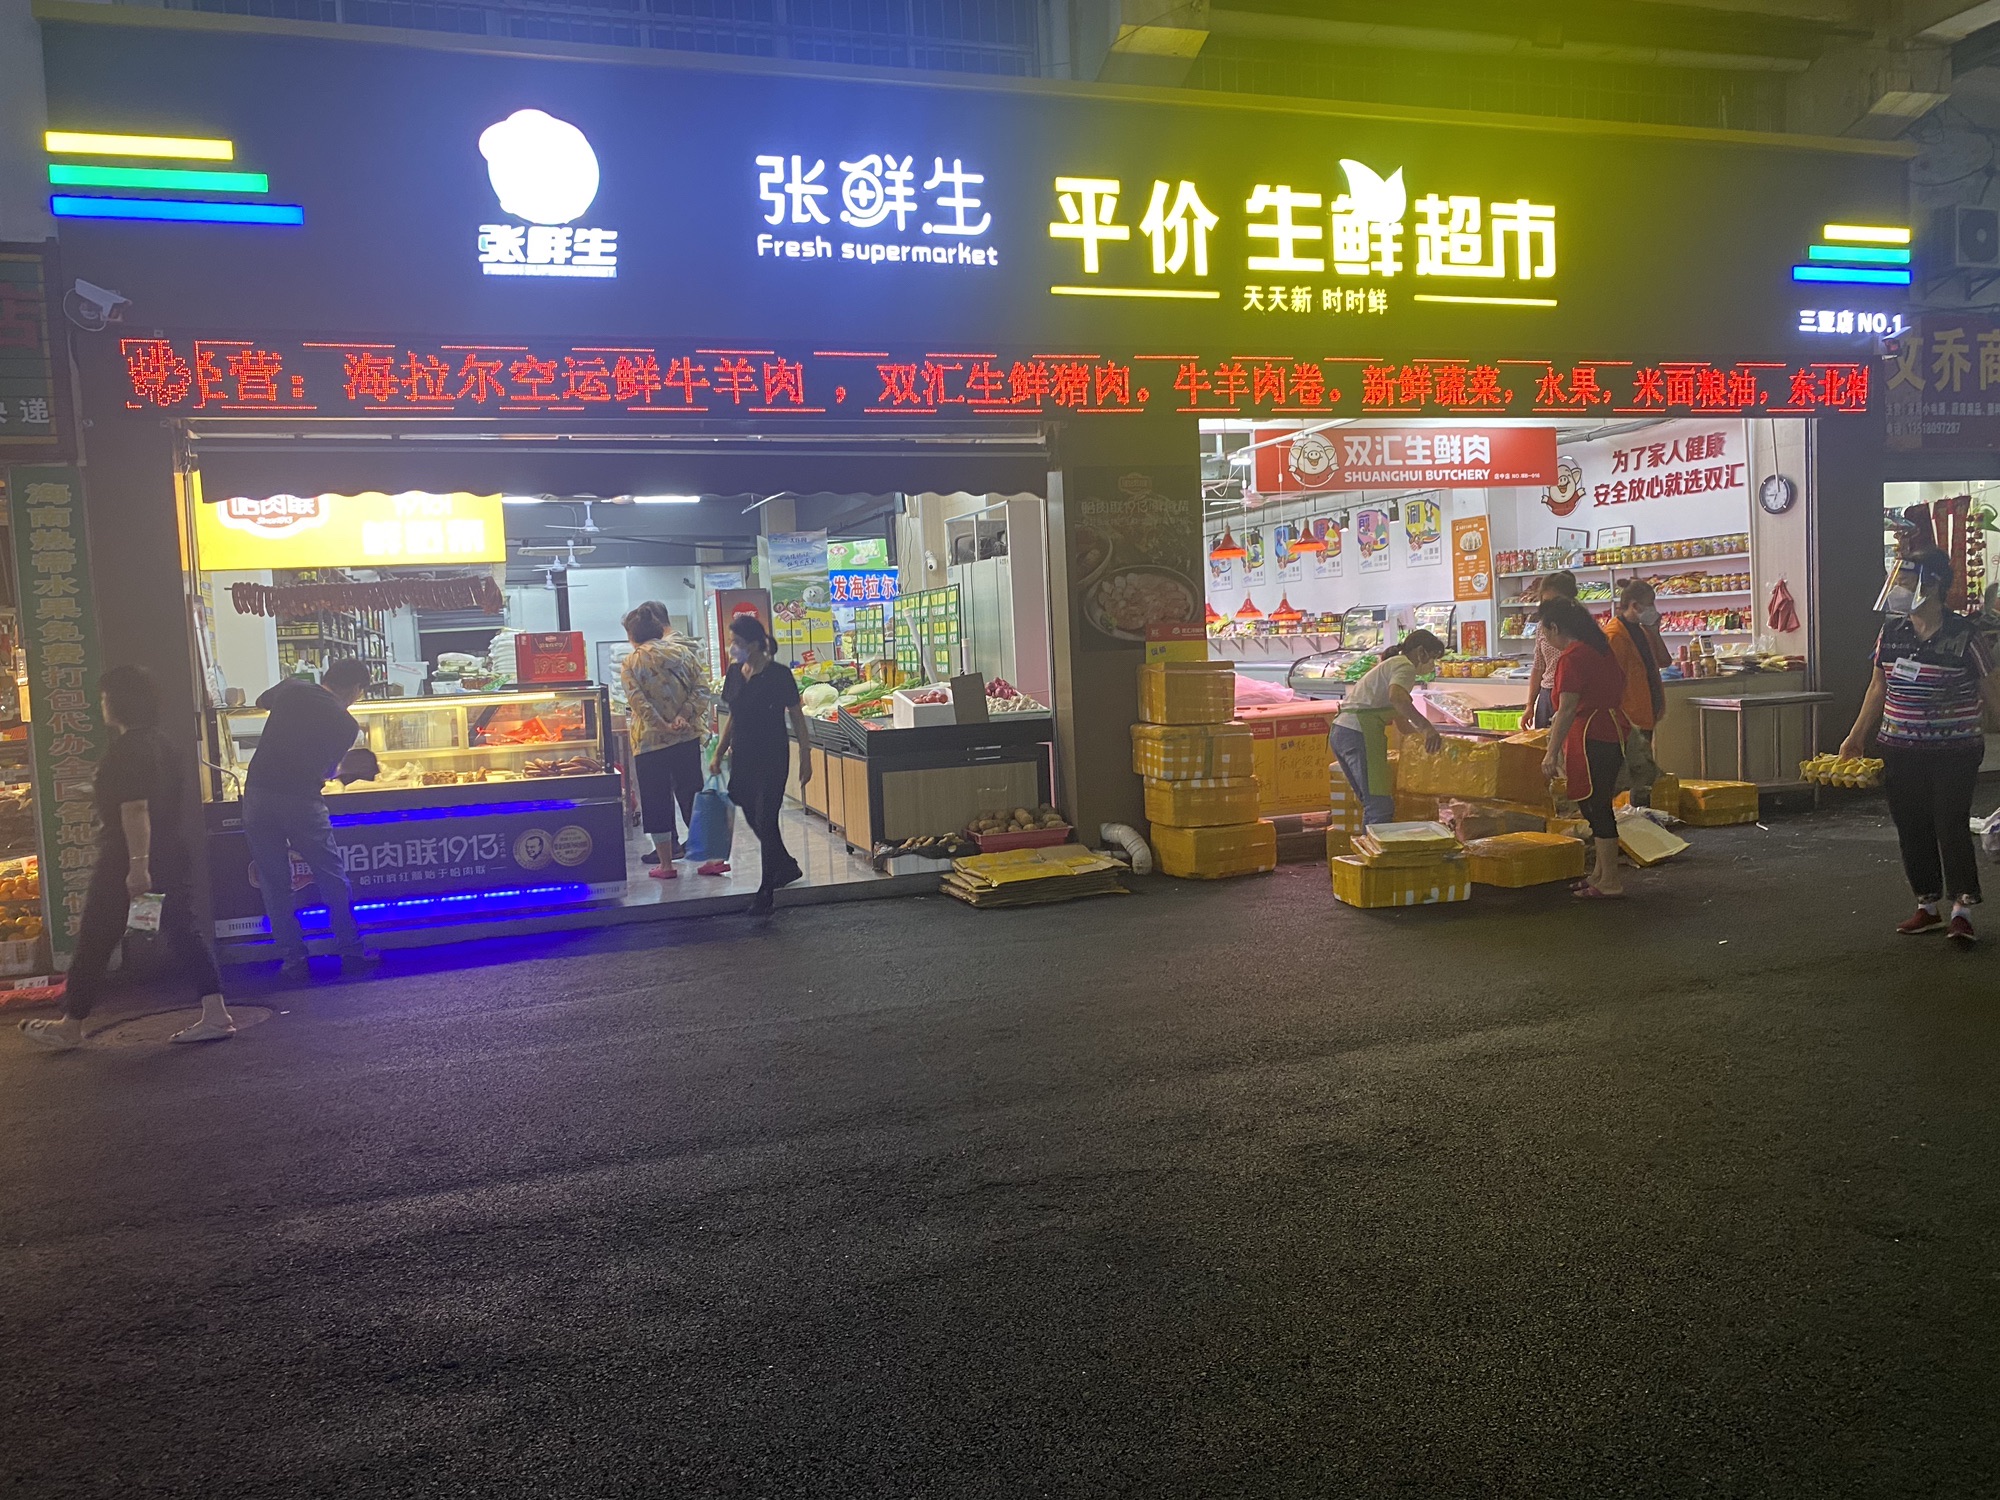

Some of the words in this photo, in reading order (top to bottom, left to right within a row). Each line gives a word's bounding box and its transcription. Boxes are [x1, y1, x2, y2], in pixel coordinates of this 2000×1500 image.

[755, 153, 992, 236] 张鲜生
[1049, 176, 1220, 277] 平价
[1245, 160, 1557, 282] 生鲜超市
[756, 233, 832, 260] Fresh
[841, 239, 999, 267] supermarket
[1242, 284, 1312, 314] 天天新
[1322, 287, 1389, 316] 时时鲜
[1798, 309, 1854, 335] 三亚店
[1857, 312, 1904, 334] NO.1
[1343, 434, 1491, 467] 双汇生鲜肉
[1611, 431, 1727, 475] 为了家人健康
[1344, 470, 1424, 483] SHUANGHUI
[1426, 468, 1491, 481] BUTCHERY
[1593, 462, 1745, 508] 安全放心就选双汇
[830, 573, 898, 601] 发海拉尔
